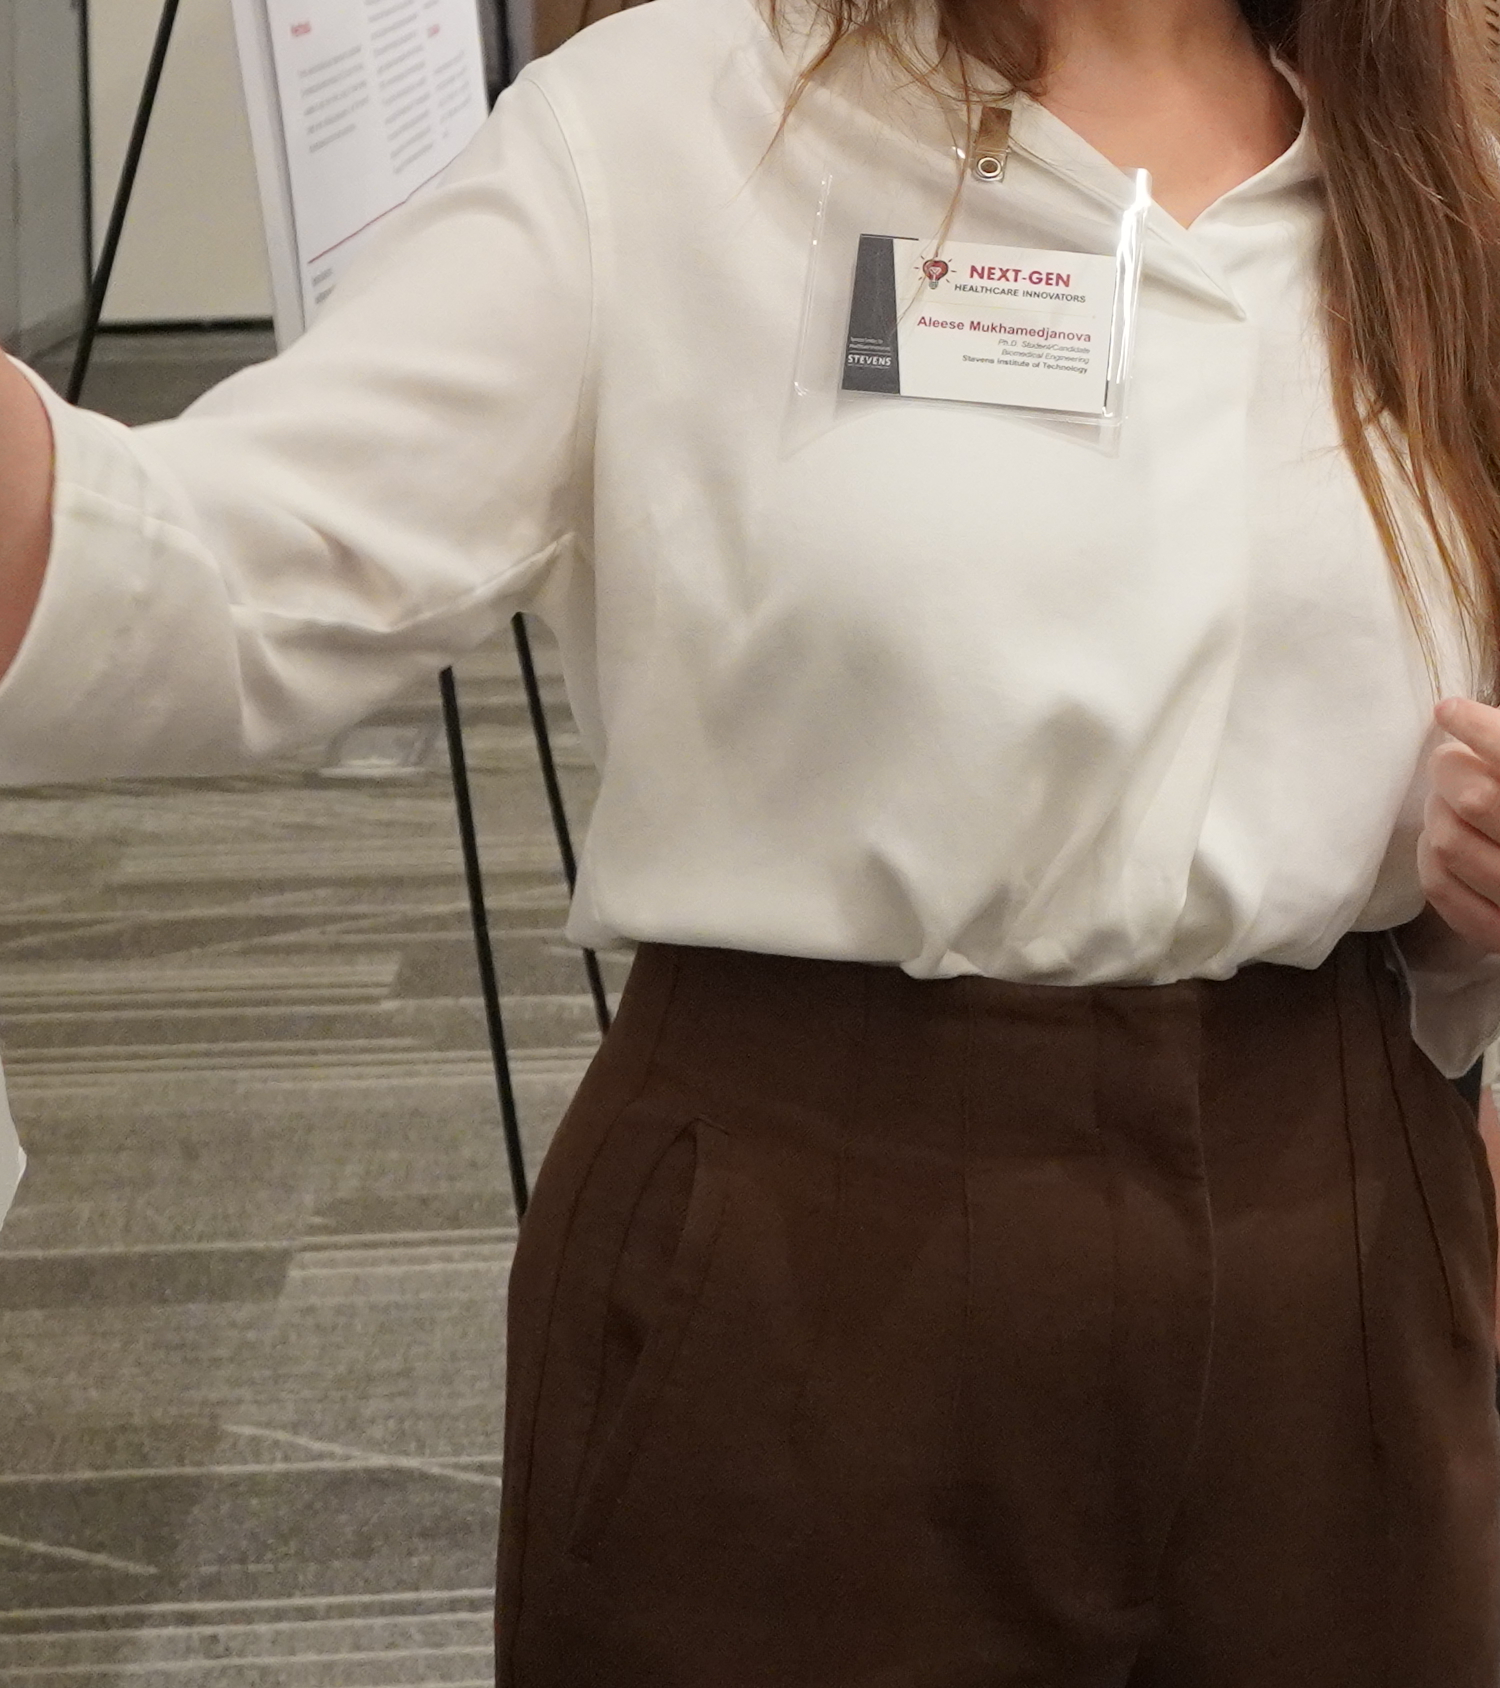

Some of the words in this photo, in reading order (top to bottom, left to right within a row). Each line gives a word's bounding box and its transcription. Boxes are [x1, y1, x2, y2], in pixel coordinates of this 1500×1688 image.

[969, 265, 1071, 288] NEXT-GEN
[954, 283, 1019, 297] HEALTHCARE
[1022, 289, 1086, 304] INNOVATORS
[917, 316, 965, 331] Aleese
[969, 321, 1092, 343] Mukhamedjanova
[848, 354, 892, 366] STEVENS
[962, 354, 995, 364] Stevens
[997, 357, 1030, 367] Institute
